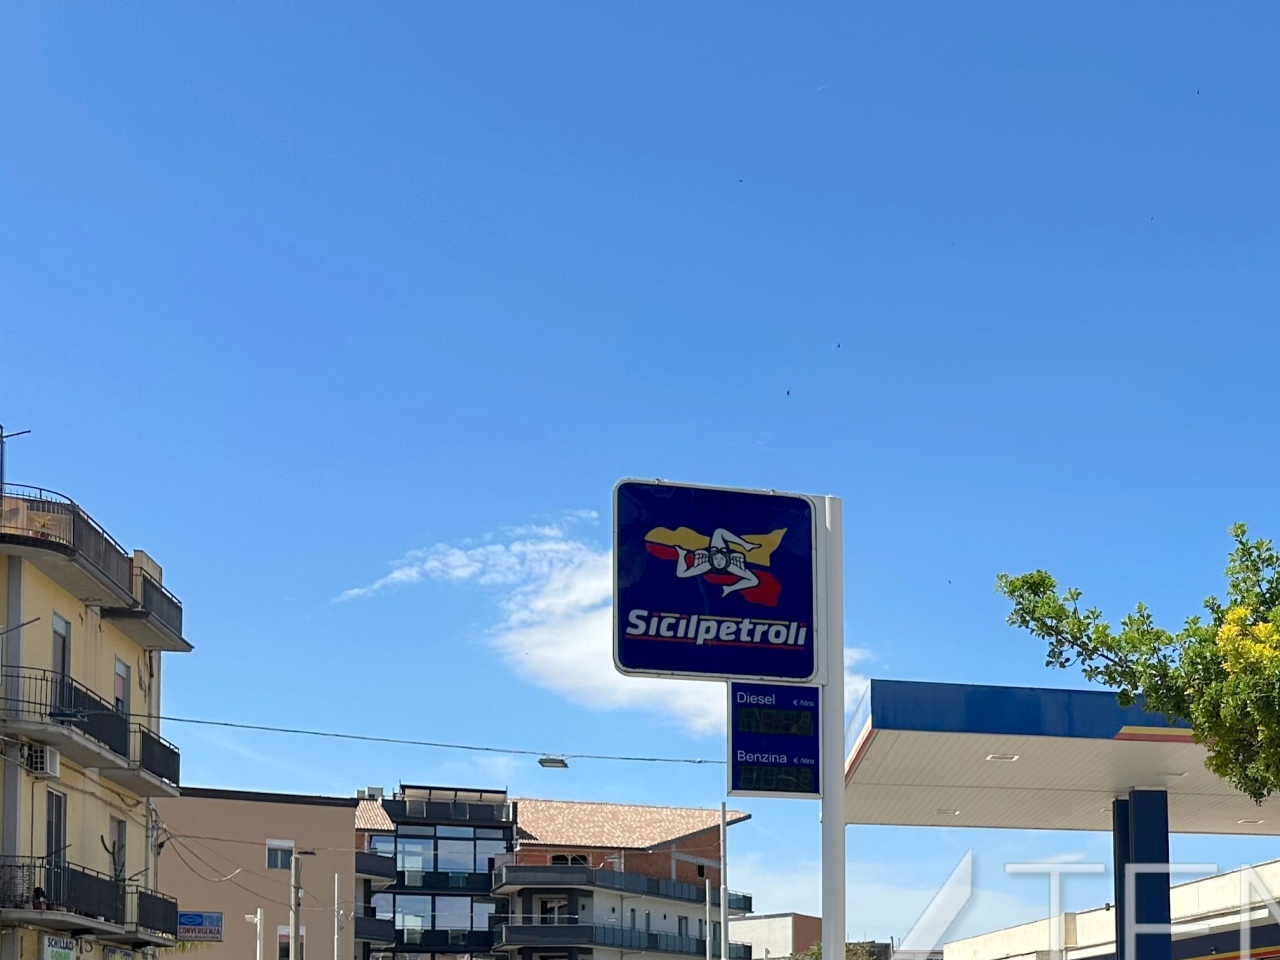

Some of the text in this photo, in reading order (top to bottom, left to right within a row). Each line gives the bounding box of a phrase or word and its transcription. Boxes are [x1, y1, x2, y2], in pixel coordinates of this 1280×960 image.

[626, 609, 807, 645] Sicilpetroli
[736, 691, 776, 705] Diesel
[736, 750, 788, 764] Benzina
[179, 927, 220, 935] CONVERGENZA
